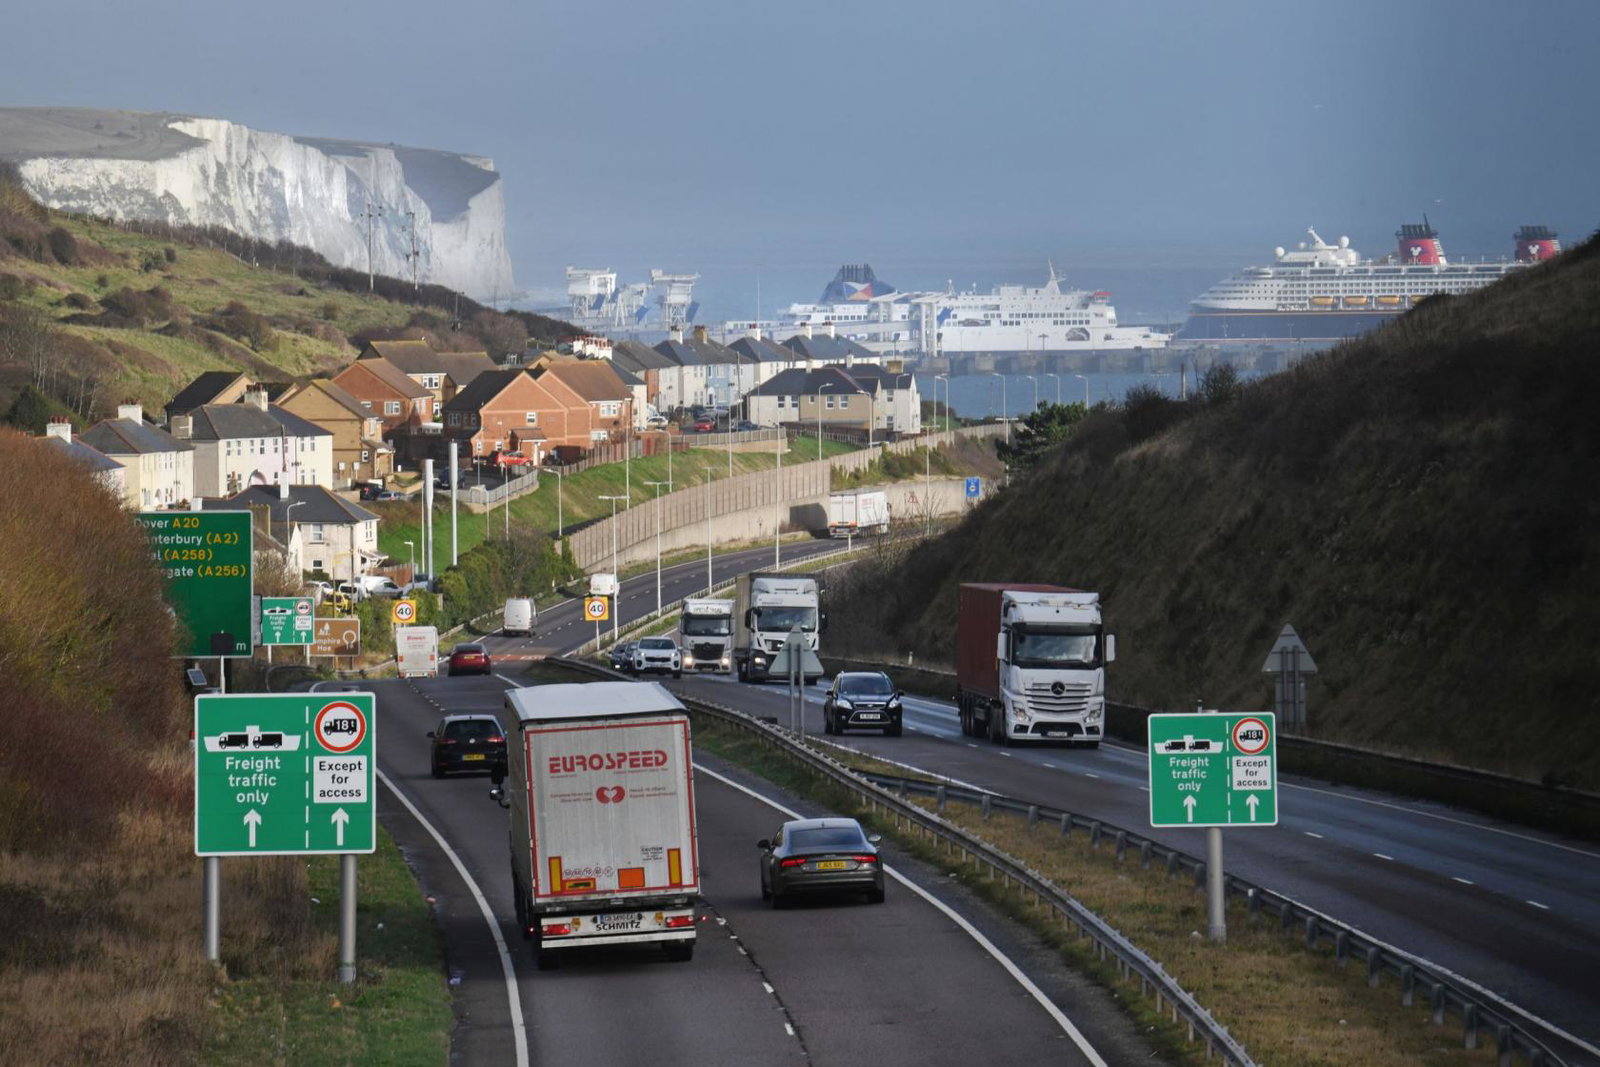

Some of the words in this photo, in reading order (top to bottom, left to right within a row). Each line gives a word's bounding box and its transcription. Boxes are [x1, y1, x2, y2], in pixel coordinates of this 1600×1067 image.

[172, 518, 200, 528] A20
[206, 532, 239, 545] (A2)
[164, 549, 213, 561] (A258)
[197, 565, 246, 577] (A256)
[397, 607, 412, 616] 40
[591, 605, 604, 613] 40
[225, 756, 281, 772] Freight
[319, 761, 362, 772] Except
[549, 750, 668, 774] EUROSPEED
[1169, 757, 1210, 768] Freight
[1236, 760, 1268, 768] Except
[331, 774, 349, 784] for
[1172, 769, 1207, 778] traffic
[228, 774, 277, 787] traffic
[1178, 781, 1202, 792] only
[236, 790, 269, 805] only
[319, 788, 362, 798] access
[596, 920, 640, 931] SCHMITZ
